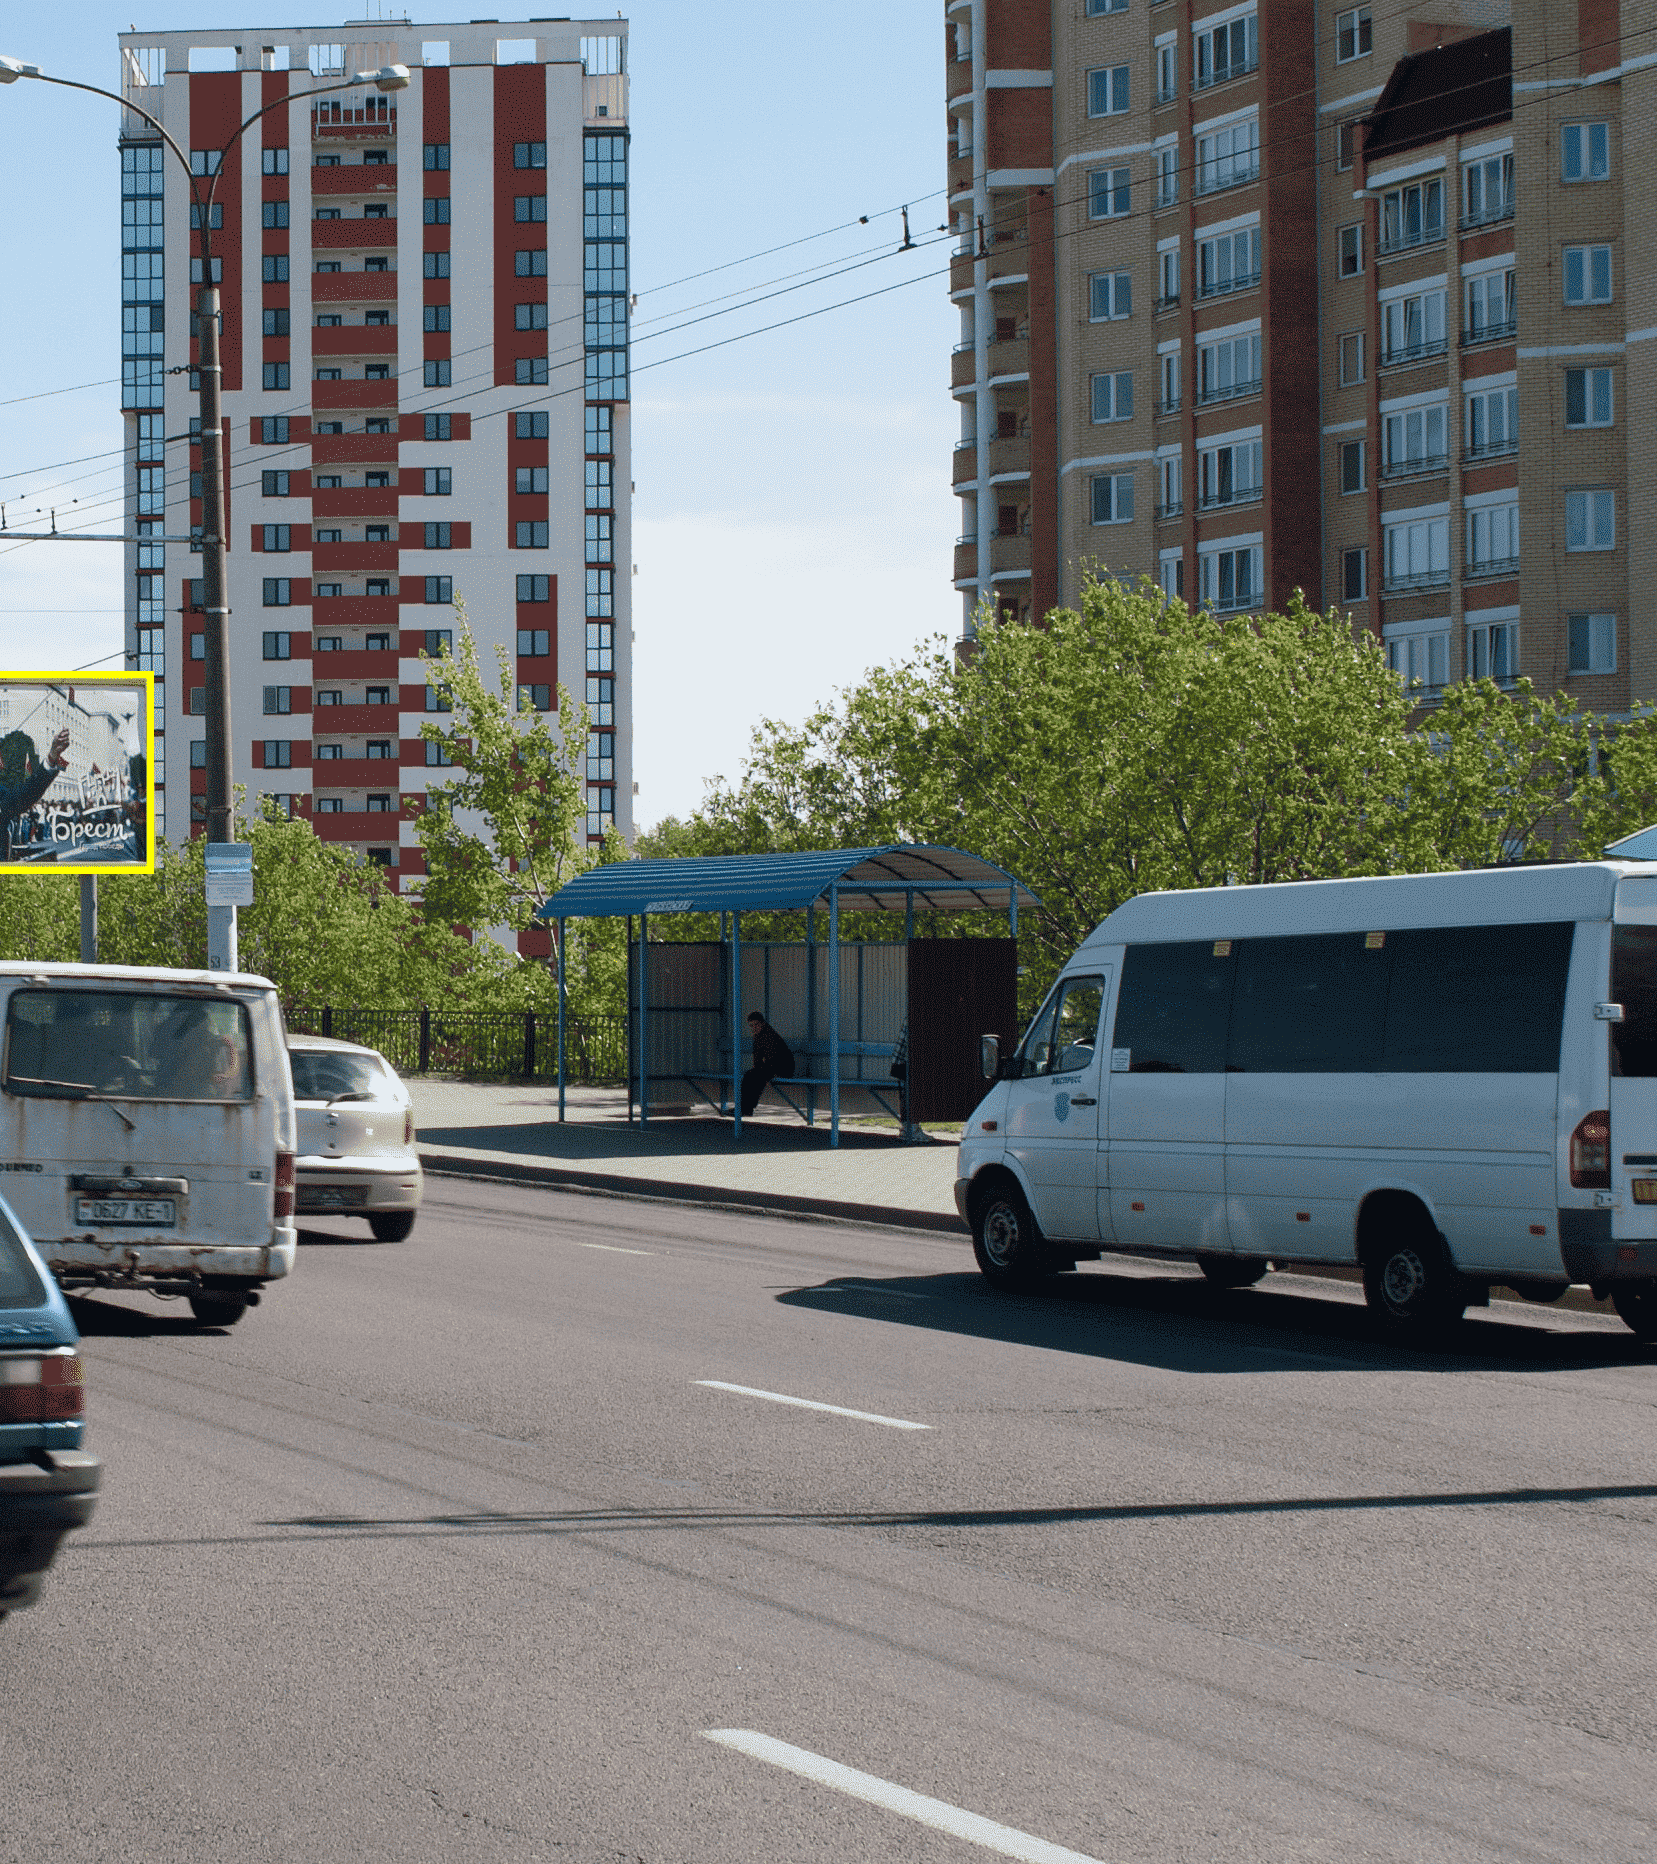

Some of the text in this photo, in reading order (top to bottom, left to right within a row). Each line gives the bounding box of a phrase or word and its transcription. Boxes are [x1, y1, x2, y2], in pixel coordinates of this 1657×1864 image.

[47, 804, 131, 846] Брест
[93, 1202, 171, 1220] 0627 KE-1
